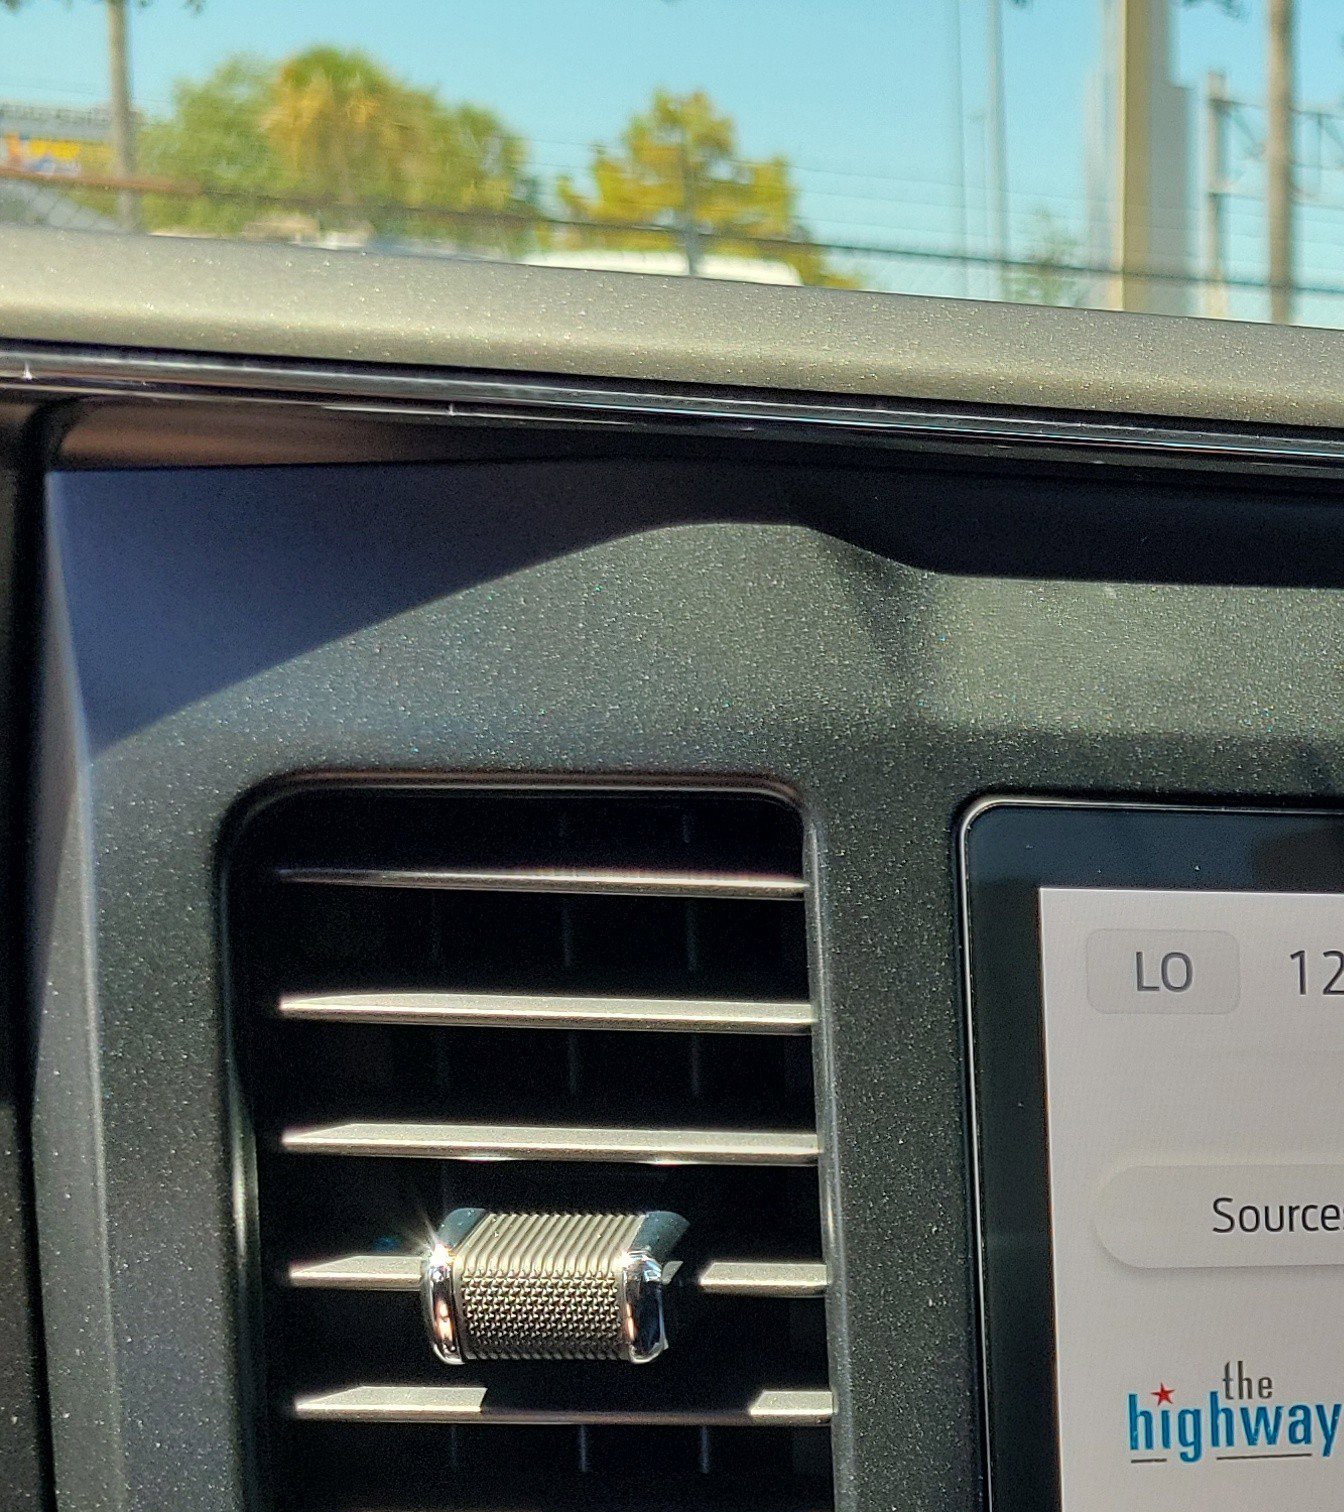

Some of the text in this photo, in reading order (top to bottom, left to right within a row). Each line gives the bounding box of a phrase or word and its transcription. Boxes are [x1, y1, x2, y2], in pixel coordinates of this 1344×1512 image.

[1135, 951, 1193, 992] LO
[1222, 1361, 1273, 1400] the
[1127, 1391, 1342, 1462] highway
